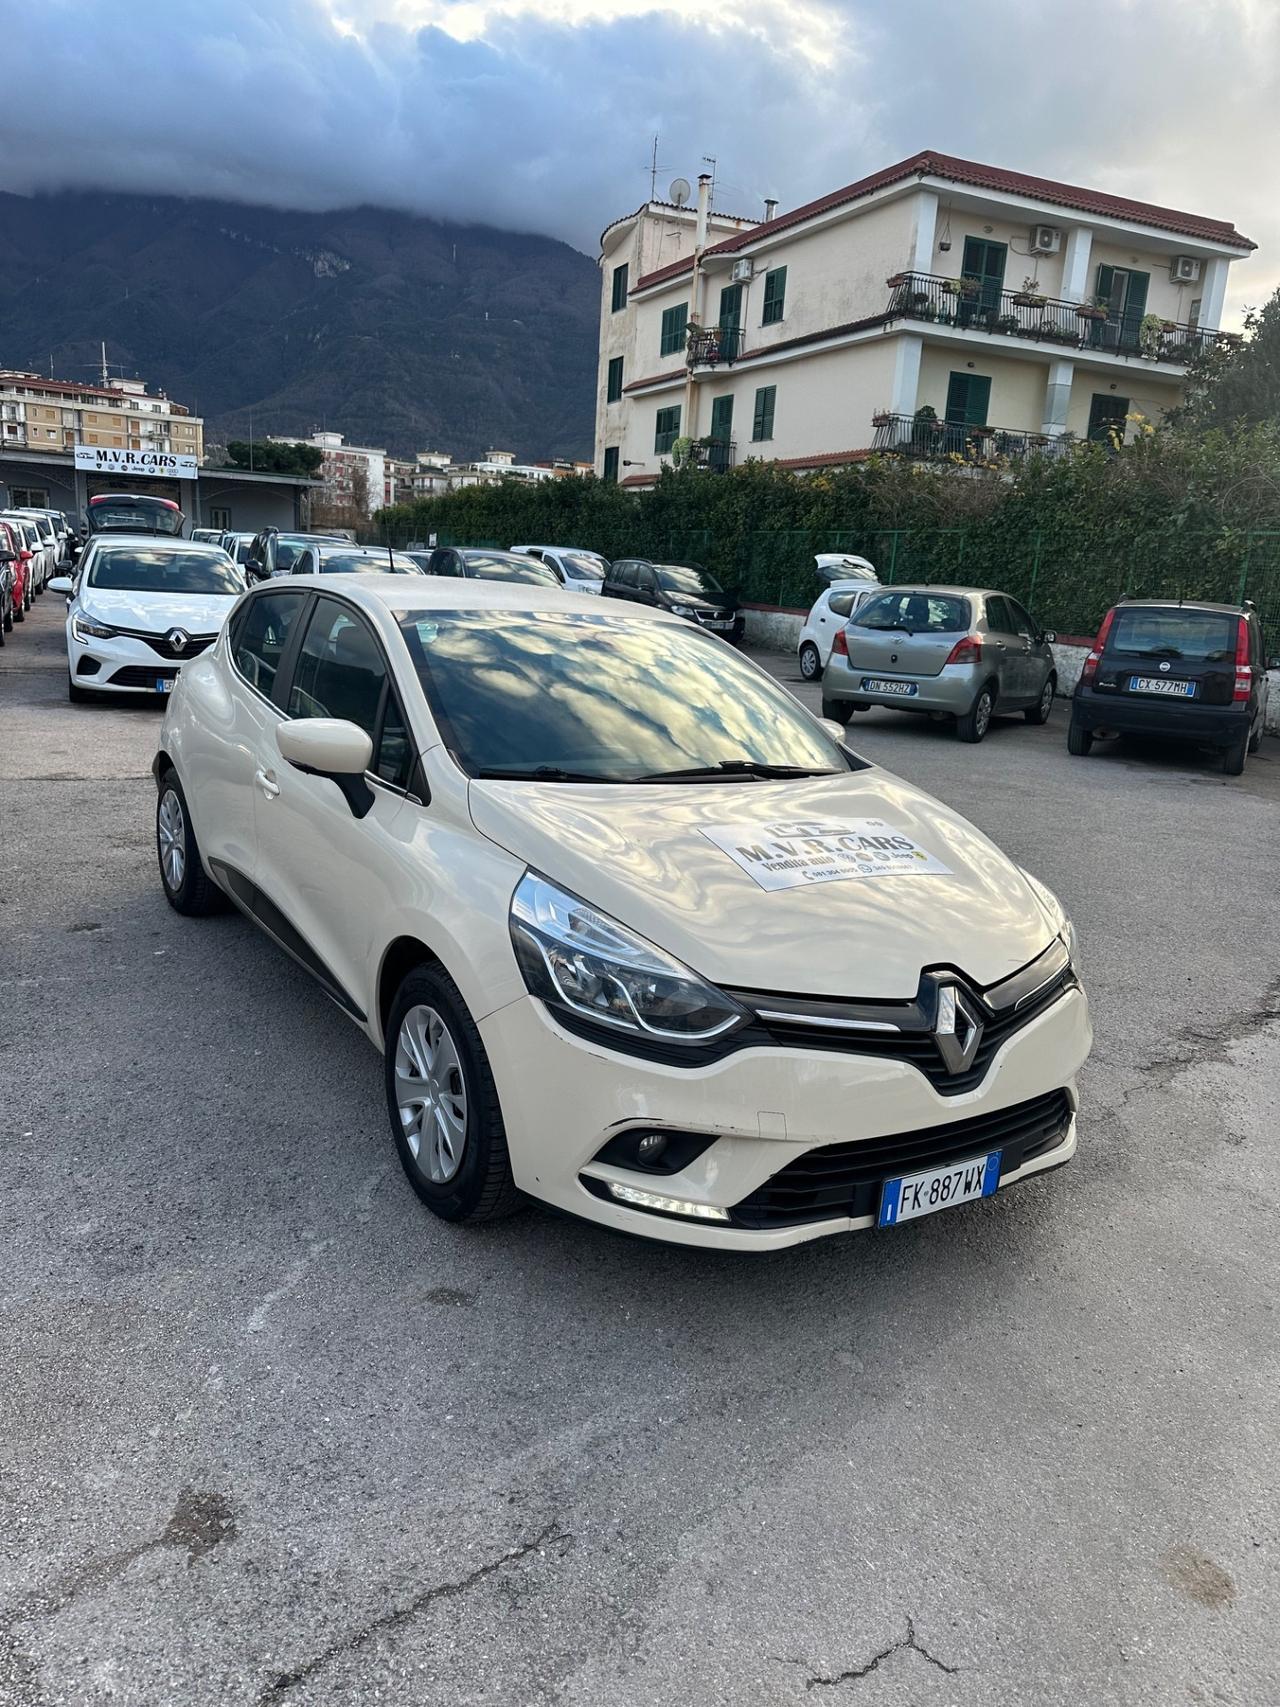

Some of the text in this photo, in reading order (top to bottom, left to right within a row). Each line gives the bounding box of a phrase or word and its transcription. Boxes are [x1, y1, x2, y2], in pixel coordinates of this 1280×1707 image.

[96, 450, 177, 468] M.V.R.CARS
[869, 680, 910, 694] DN 552HZ
[1138, 680, 1188, 693] CX 577MH
[900, 1181, 925, 1214] FK
[929, 1164, 985, 1205] 887WX
